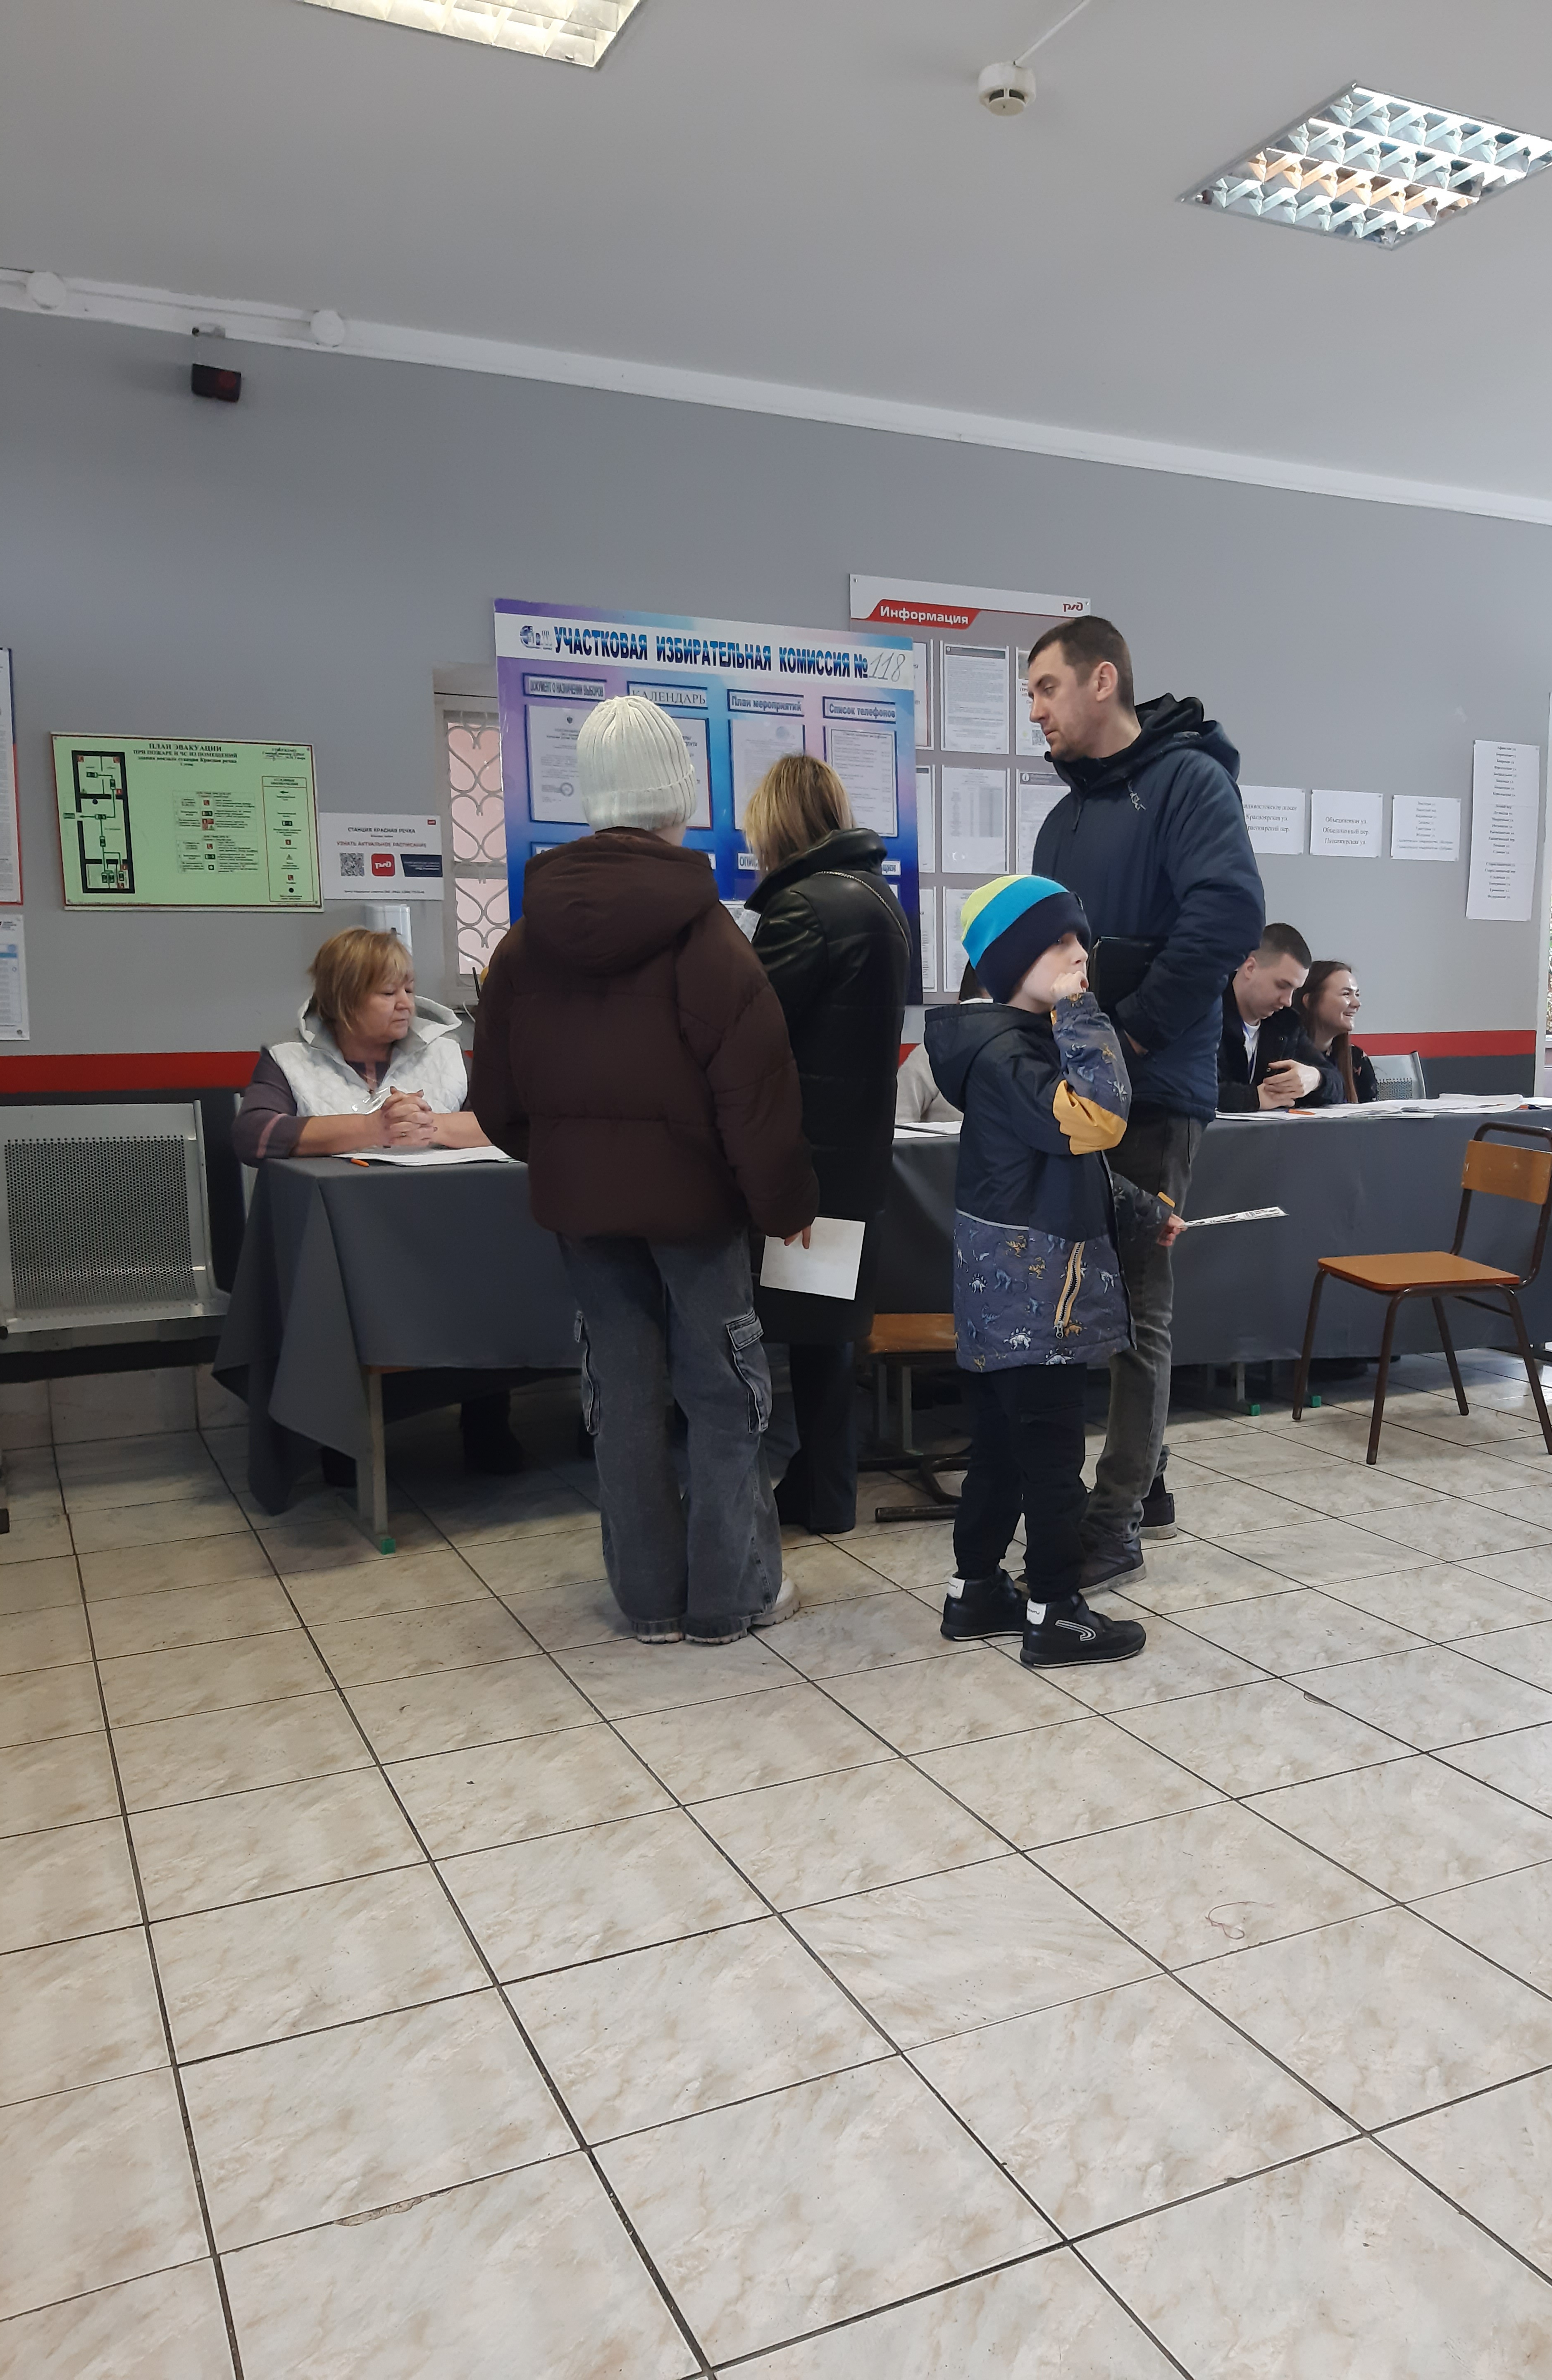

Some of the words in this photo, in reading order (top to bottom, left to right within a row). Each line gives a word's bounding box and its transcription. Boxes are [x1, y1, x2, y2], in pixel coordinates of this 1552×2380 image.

[880, 605, 968, 625] Информация
[553, 626, 648, 661] УЧАСТКОВАЯ
[656, 635, 772, 671] ИЗБИРАТЕЛЬНАЯ
[779, 647, 850, 678] КОМИССИЯ
[853, 653, 868, 679] №
[868, 652, 906, 682] 118
[732, 695, 751, 707] План
[753, 700, 801, 713] мероприятий
[829, 703, 856, 715] Список
[857, 707, 896, 719] телефонов
